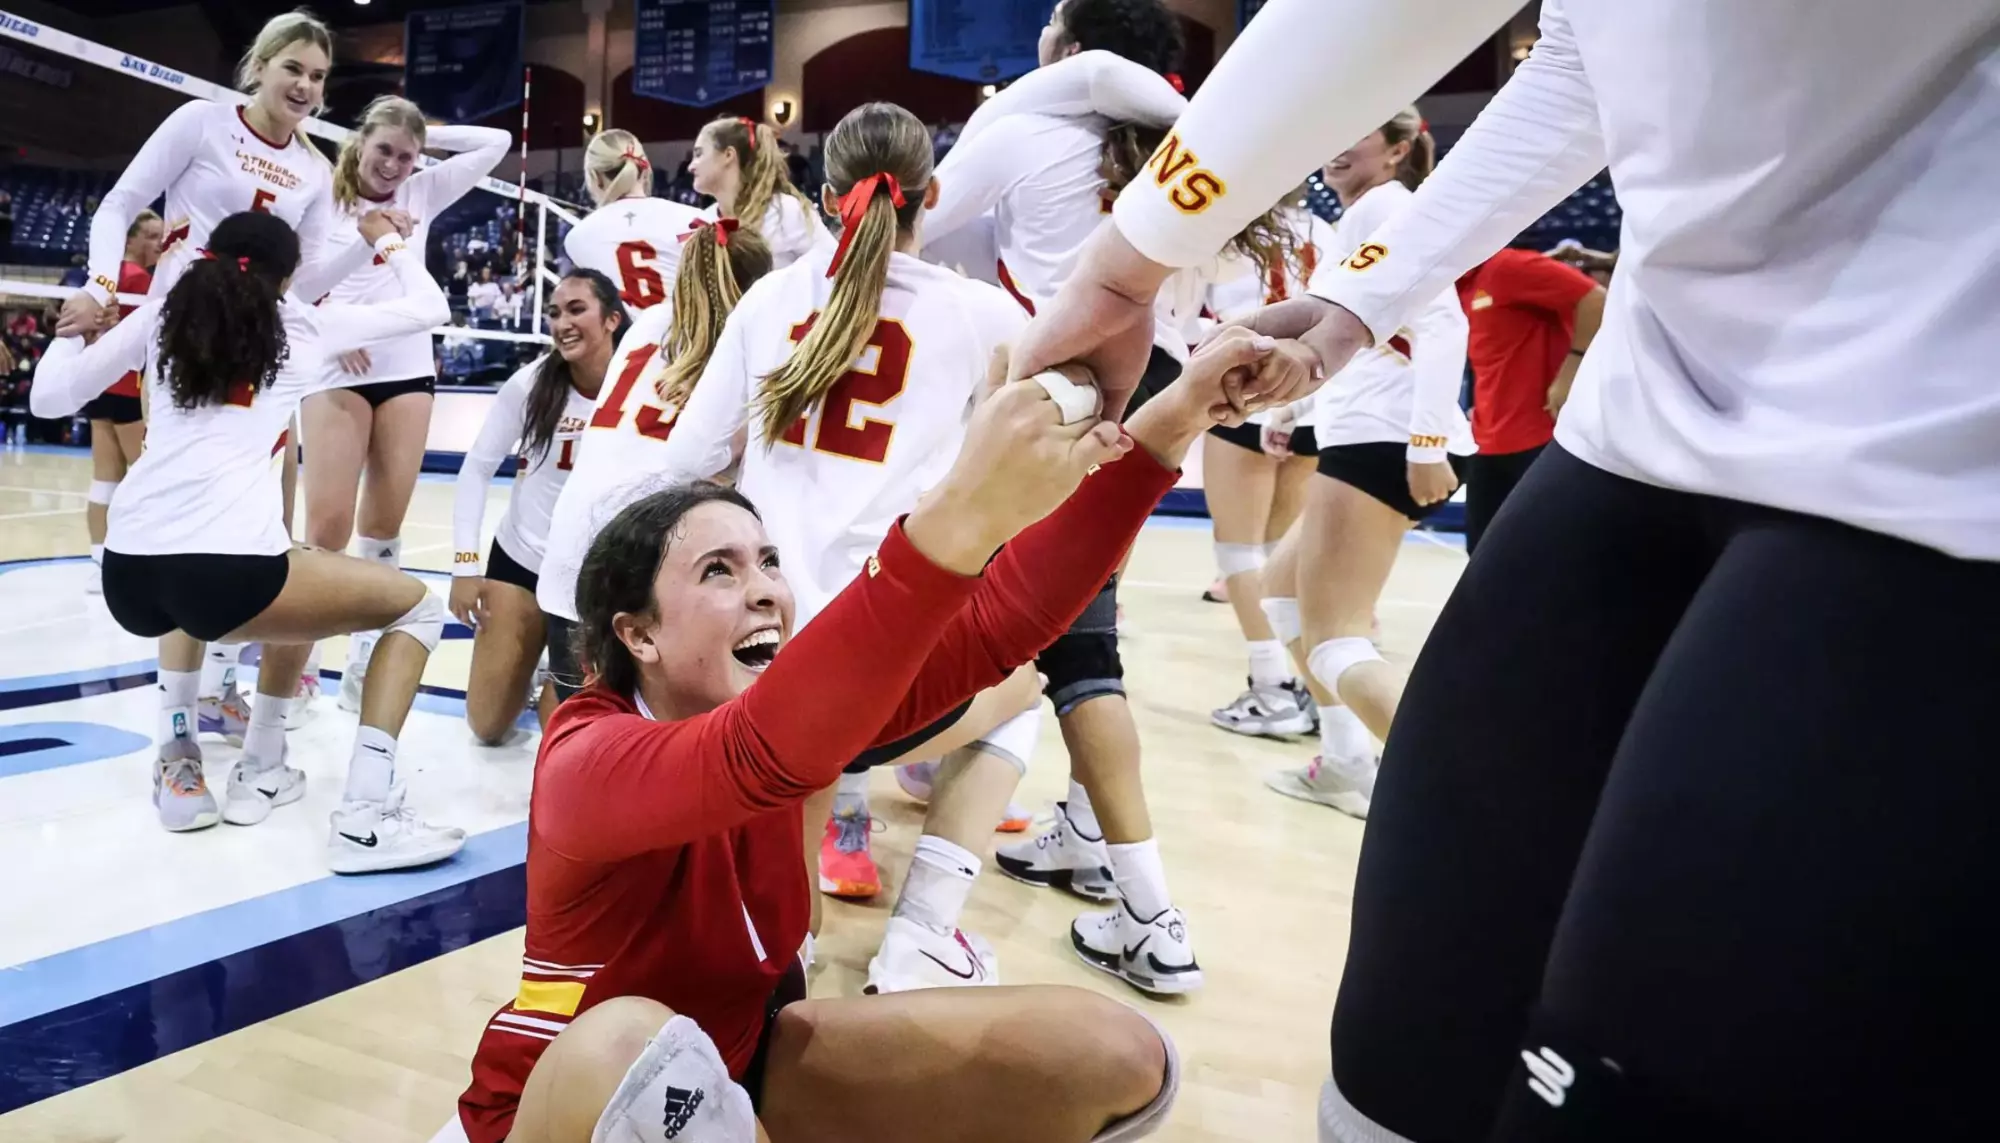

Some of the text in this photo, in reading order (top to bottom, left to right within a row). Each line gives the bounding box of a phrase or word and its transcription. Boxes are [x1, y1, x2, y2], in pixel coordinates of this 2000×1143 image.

[617, 240, 666, 310] 6
[1340, 243, 1388, 272] S
[664, 1087, 705, 1140] adidas
